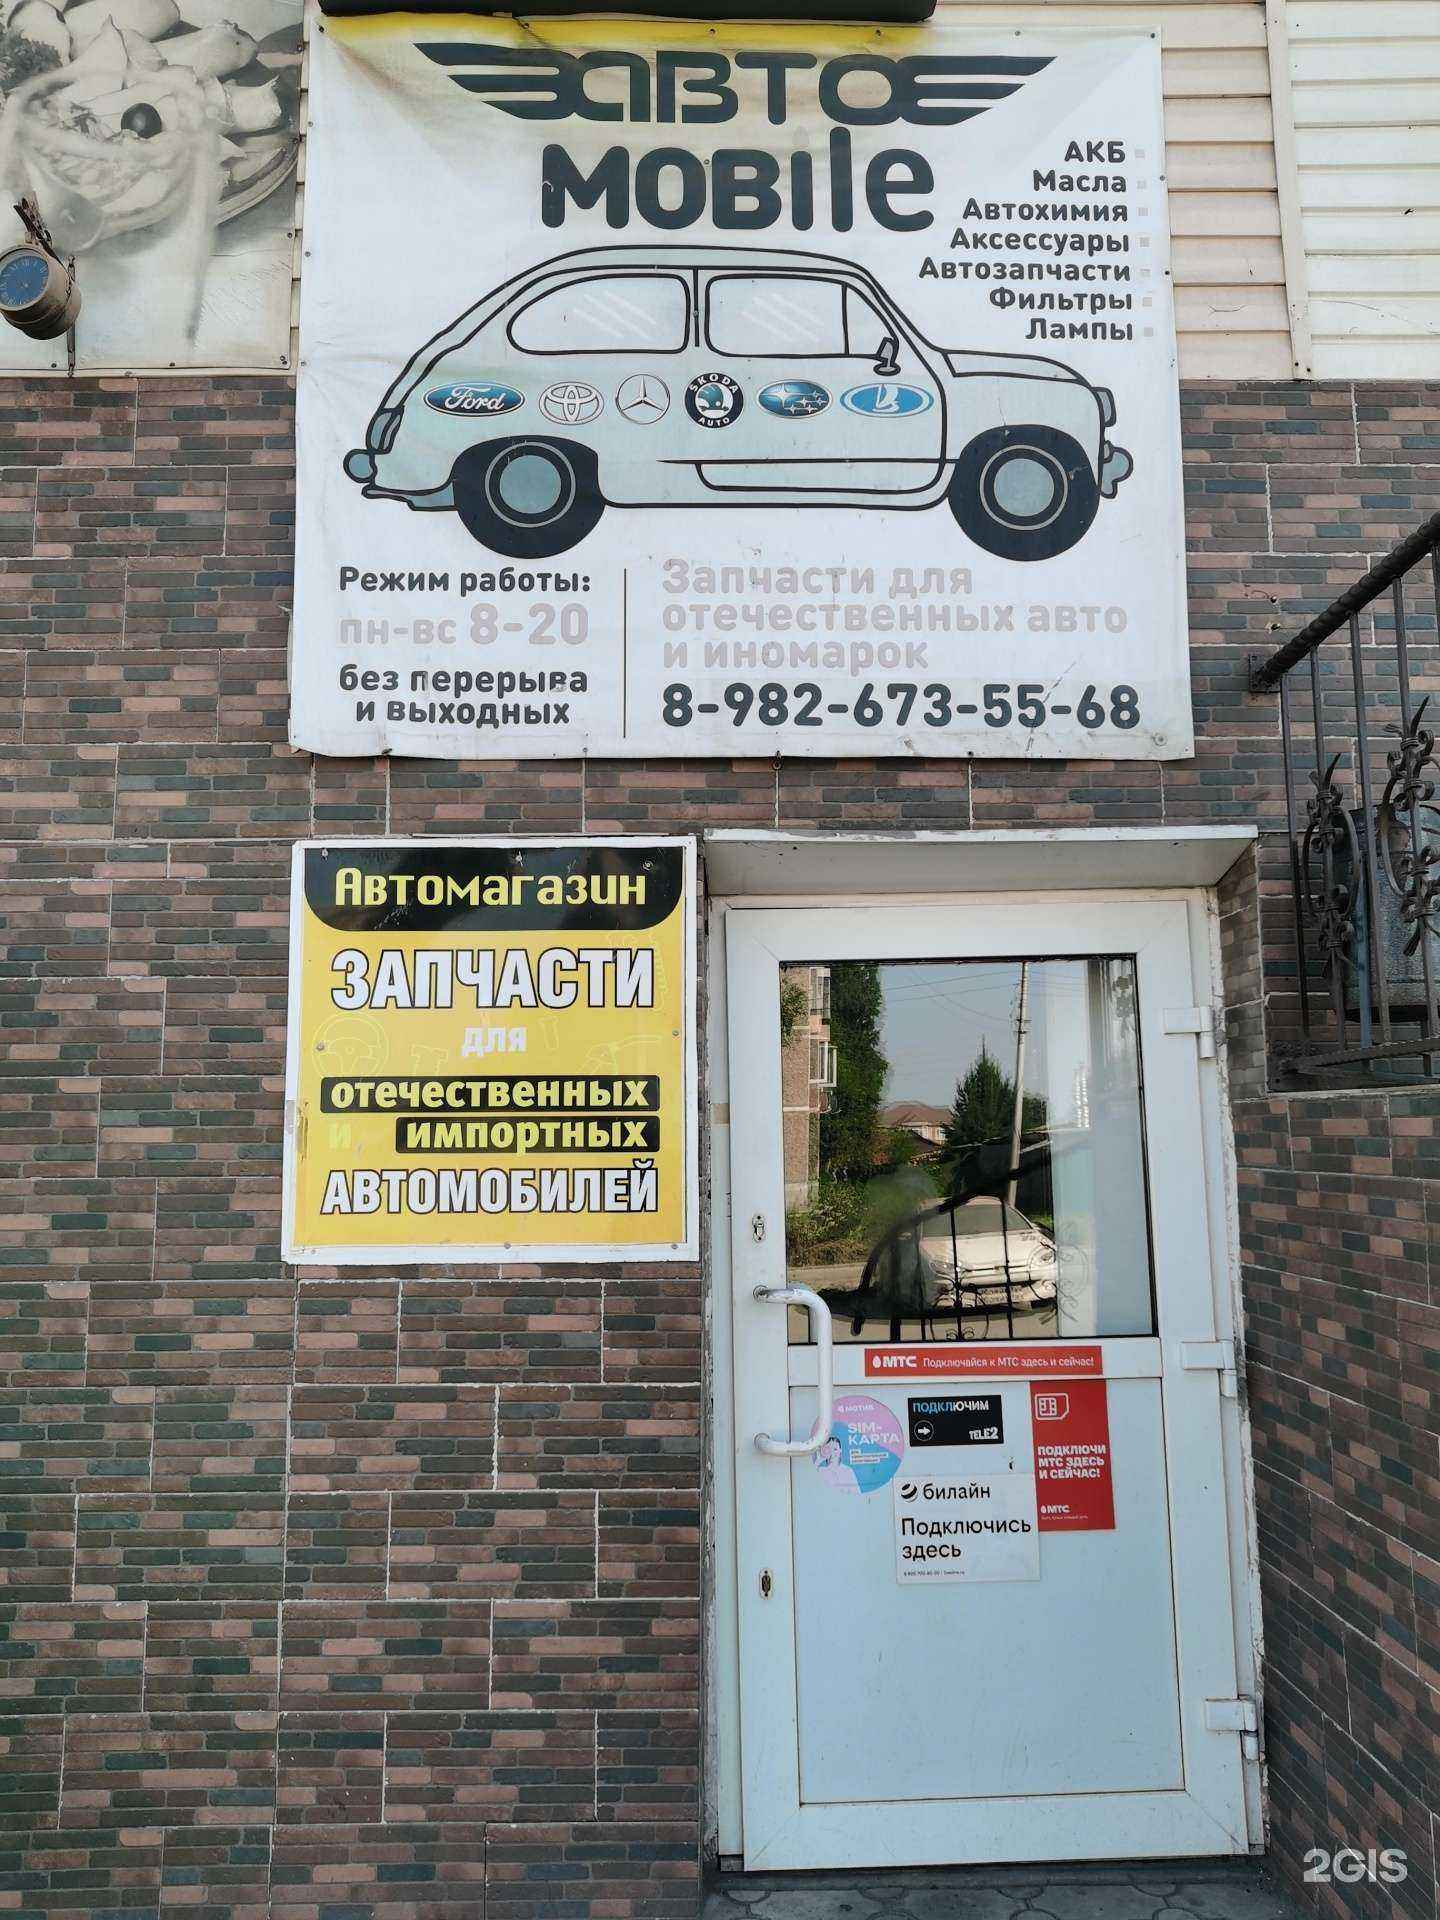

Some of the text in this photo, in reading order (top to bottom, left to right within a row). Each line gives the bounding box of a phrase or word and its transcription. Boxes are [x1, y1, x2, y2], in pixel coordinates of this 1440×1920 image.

[1064, 140, 1126, 163] АКБ
[1033, 169, 1127, 193] Масла
[962, 197, 1129, 222] Автохимия
[950, 227, 1130, 257] Аксессуары
[918, 256, 1131, 281] Автозапчасти
[989, 286, 1132, 315] Фильтры
[1025, 317, 1133, 341] Лампы
[444, 387, 505, 412] Ford
[698, 416, 730, 428] AUTO
[339, 566, 592, 598] Режим работы:
[662, 558, 973, 600] Запчасти для
[340, 603, 589, 645] пн-вс 8-20
[662, 601, 1128, 633] отечественных авто
[663, 641, 929, 677] и иномарок
[339, 664, 588, 699] без перерыва
[356, 701, 570, 729] и выходных
[662, 682, 1141, 730] 8-982-673-55-68
[334, 867, 647, 907] Автомагазин
[331, 947, 655, 1010] ЗАПЧАСТИ
[461, 1026, 527, 1058] для
[330, 1079, 649, 1109] отечественных
[328, 1120, 649, 1156] и импортных
[320, 1158, 660, 1215] АВТОМОБИЛЕЙ
[882, 1356, 917, 1368] МТС
[923, 1357, 988, 1370] Подключайся
[997, 1357, 1019, 1367] МТС
[1021, 1358, 1048, 1369] здесь
[1058, 1355, 1094, 1367] сейчас!
[913, 1400, 989, 1415] ПОДКЛЮЧИМ
[848, 1433, 900, 1446] КАРТА
[969, 1427, 999, 1440] TELE2
[1037, 1445, 1106, 1456] ПОДКЛЮЧИ
[1038, 1457, 1105, 1468] МТС ЗДЕСЬ
[1039, 1467, 1101, 1479] И СЕЙЧАС!
[923, 1483, 991, 1500] билайн
[1047, 1504, 1070, 1514] МТС
[901, 1517, 1031, 1537] Подключись
[902, 1544, 962, 1561] здесь
